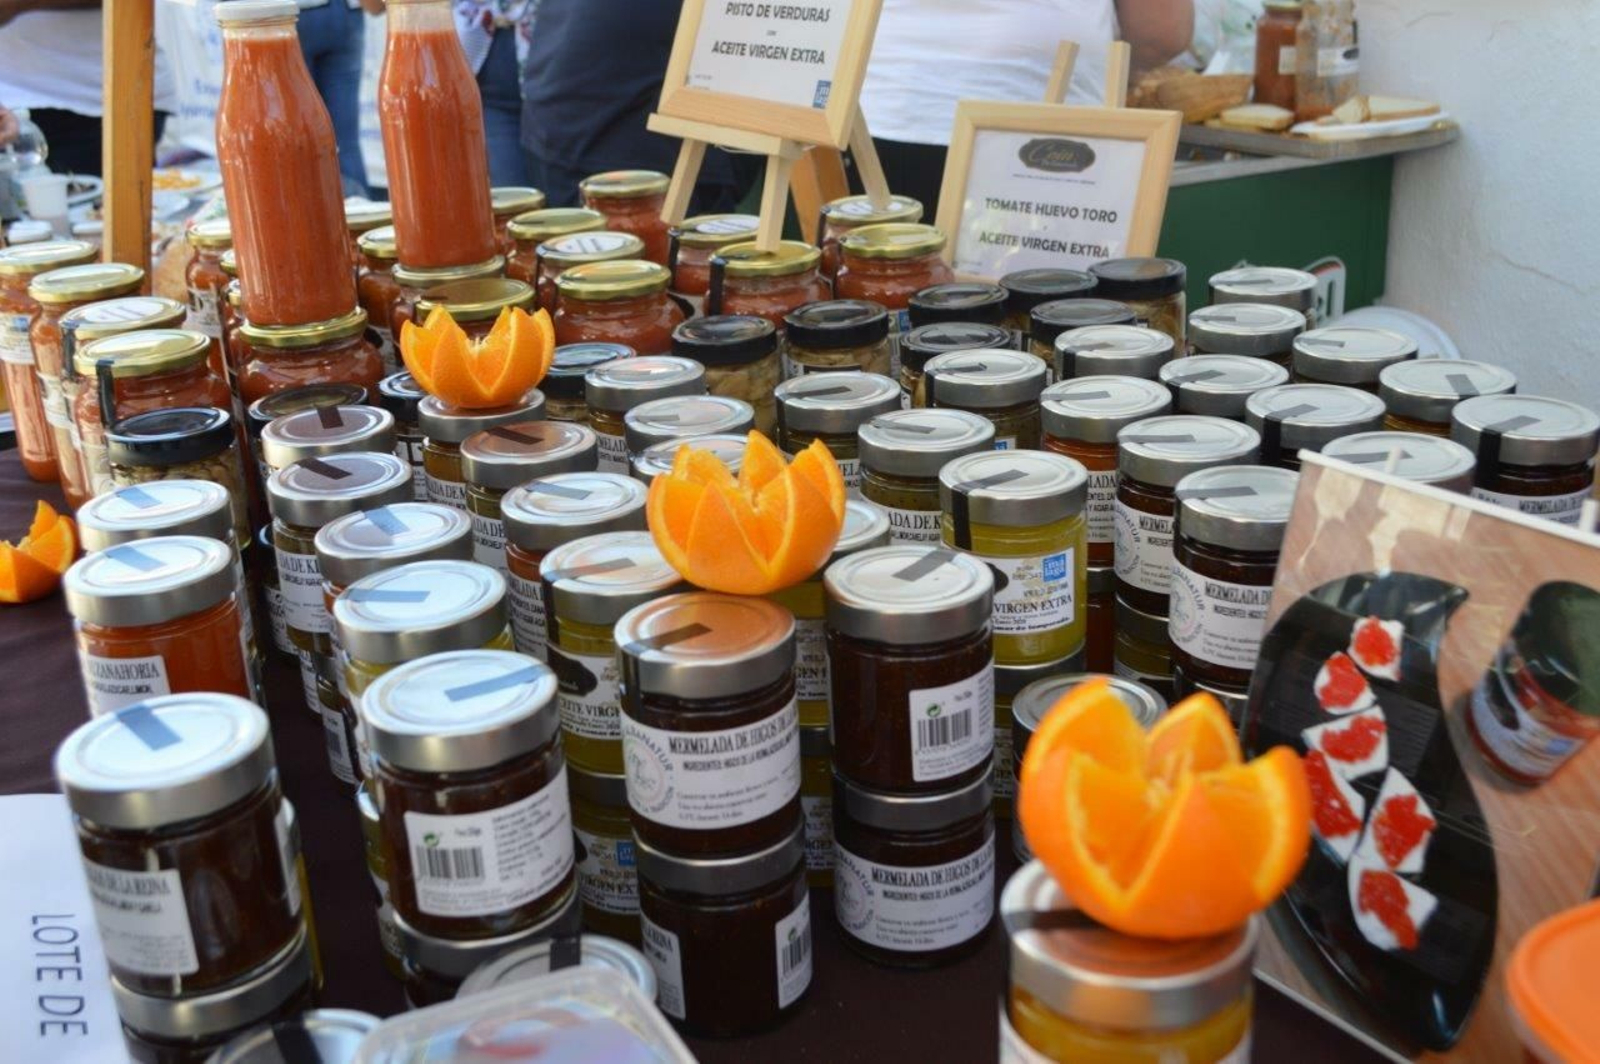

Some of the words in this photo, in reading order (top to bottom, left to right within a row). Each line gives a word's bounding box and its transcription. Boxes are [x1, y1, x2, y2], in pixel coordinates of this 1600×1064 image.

[725, 2, 755, 17] PISTO
[756, 5, 771, 18] DE
[773, 6, 831, 23] VERDURAS
[711, 41, 746, 57] ACEITE
[748, 44, 789, 61] VIRGEN
[790, 48, 826, 65] EXTRA
[985, 197, 1033, 215] TOMATE
[1035, 202, 1080, 220] HUEVO
[1082, 207, 1119, 224] TORO
[979, 230, 1020, 247] ACEITE
[1021, 236, 1068, 254] VIRGEN
[1070, 242, 1110, 259] EXTRA
[994, 600, 1039, 614] VIRGEN
[1040, 594, 1072, 611] EXTRA
[668, 736, 733, 754] MERMELADA
[735, 733, 751, 749] DE
[871, 866, 930, 887] MERMELADA
[931, 871, 943, 886] DE
[32, 913, 83, 981] LOTE
[38, 995, 88, 1036] DE
